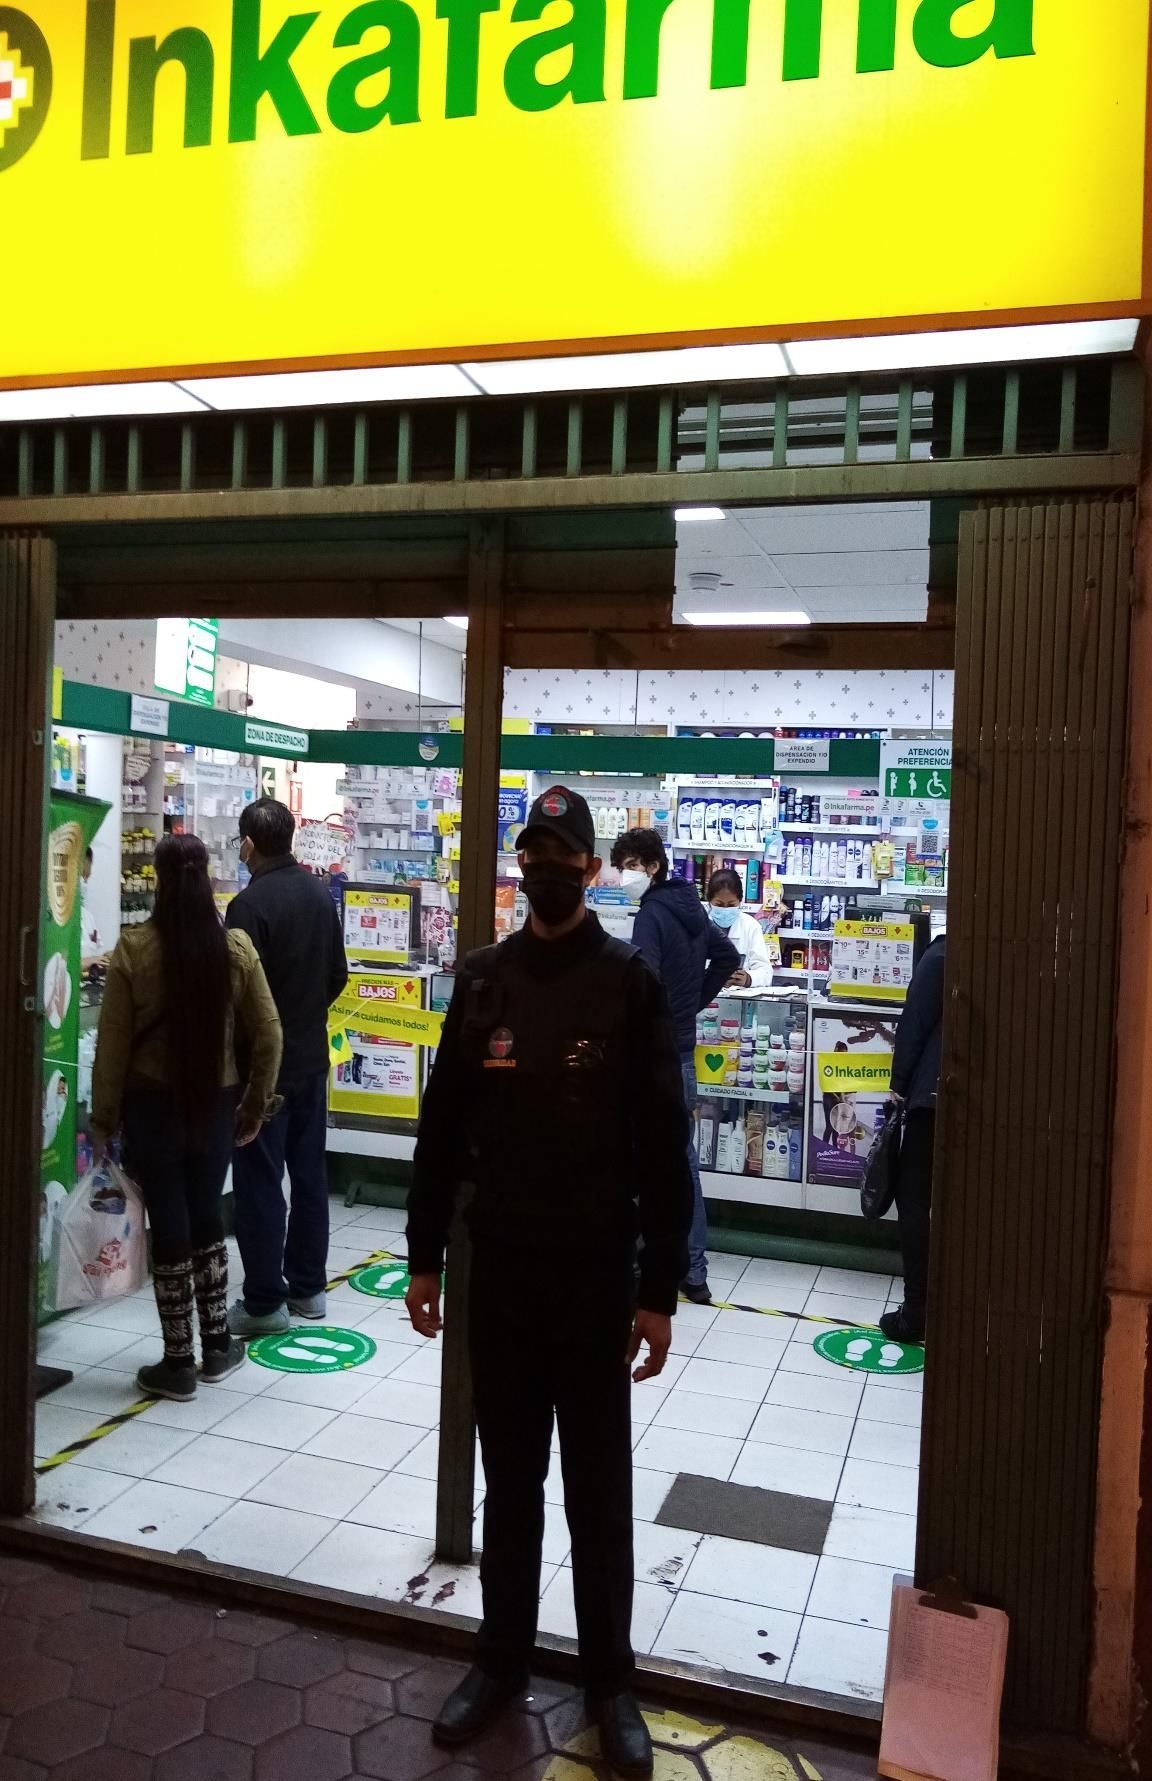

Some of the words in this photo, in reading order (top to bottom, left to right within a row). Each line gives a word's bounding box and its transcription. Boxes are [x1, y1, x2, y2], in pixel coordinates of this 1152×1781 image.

[81, 0, 1037, 162] Inkafarma
[247, 728, 265, 741] ZONA
[266, 731, 274, 742] DE
[274, 732, 305, 748] DESPACHO
[907, 746, 949, 756] ATENCIÓN
[897, 757, 952, 766] PREFERENCIA
[863, 927, 887, 935] BAJOS
[358, 985, 396, 999] BAJOS
[361, 1012, 402, 1027] cuidamos
[402, 1019, 430, 1031] todos!
[835, 1065, 891, 1078] Inkafarm
[709, 1087, 731, 1096] CUIDADO
[731, 1088, 748, 1097] FACIAL
